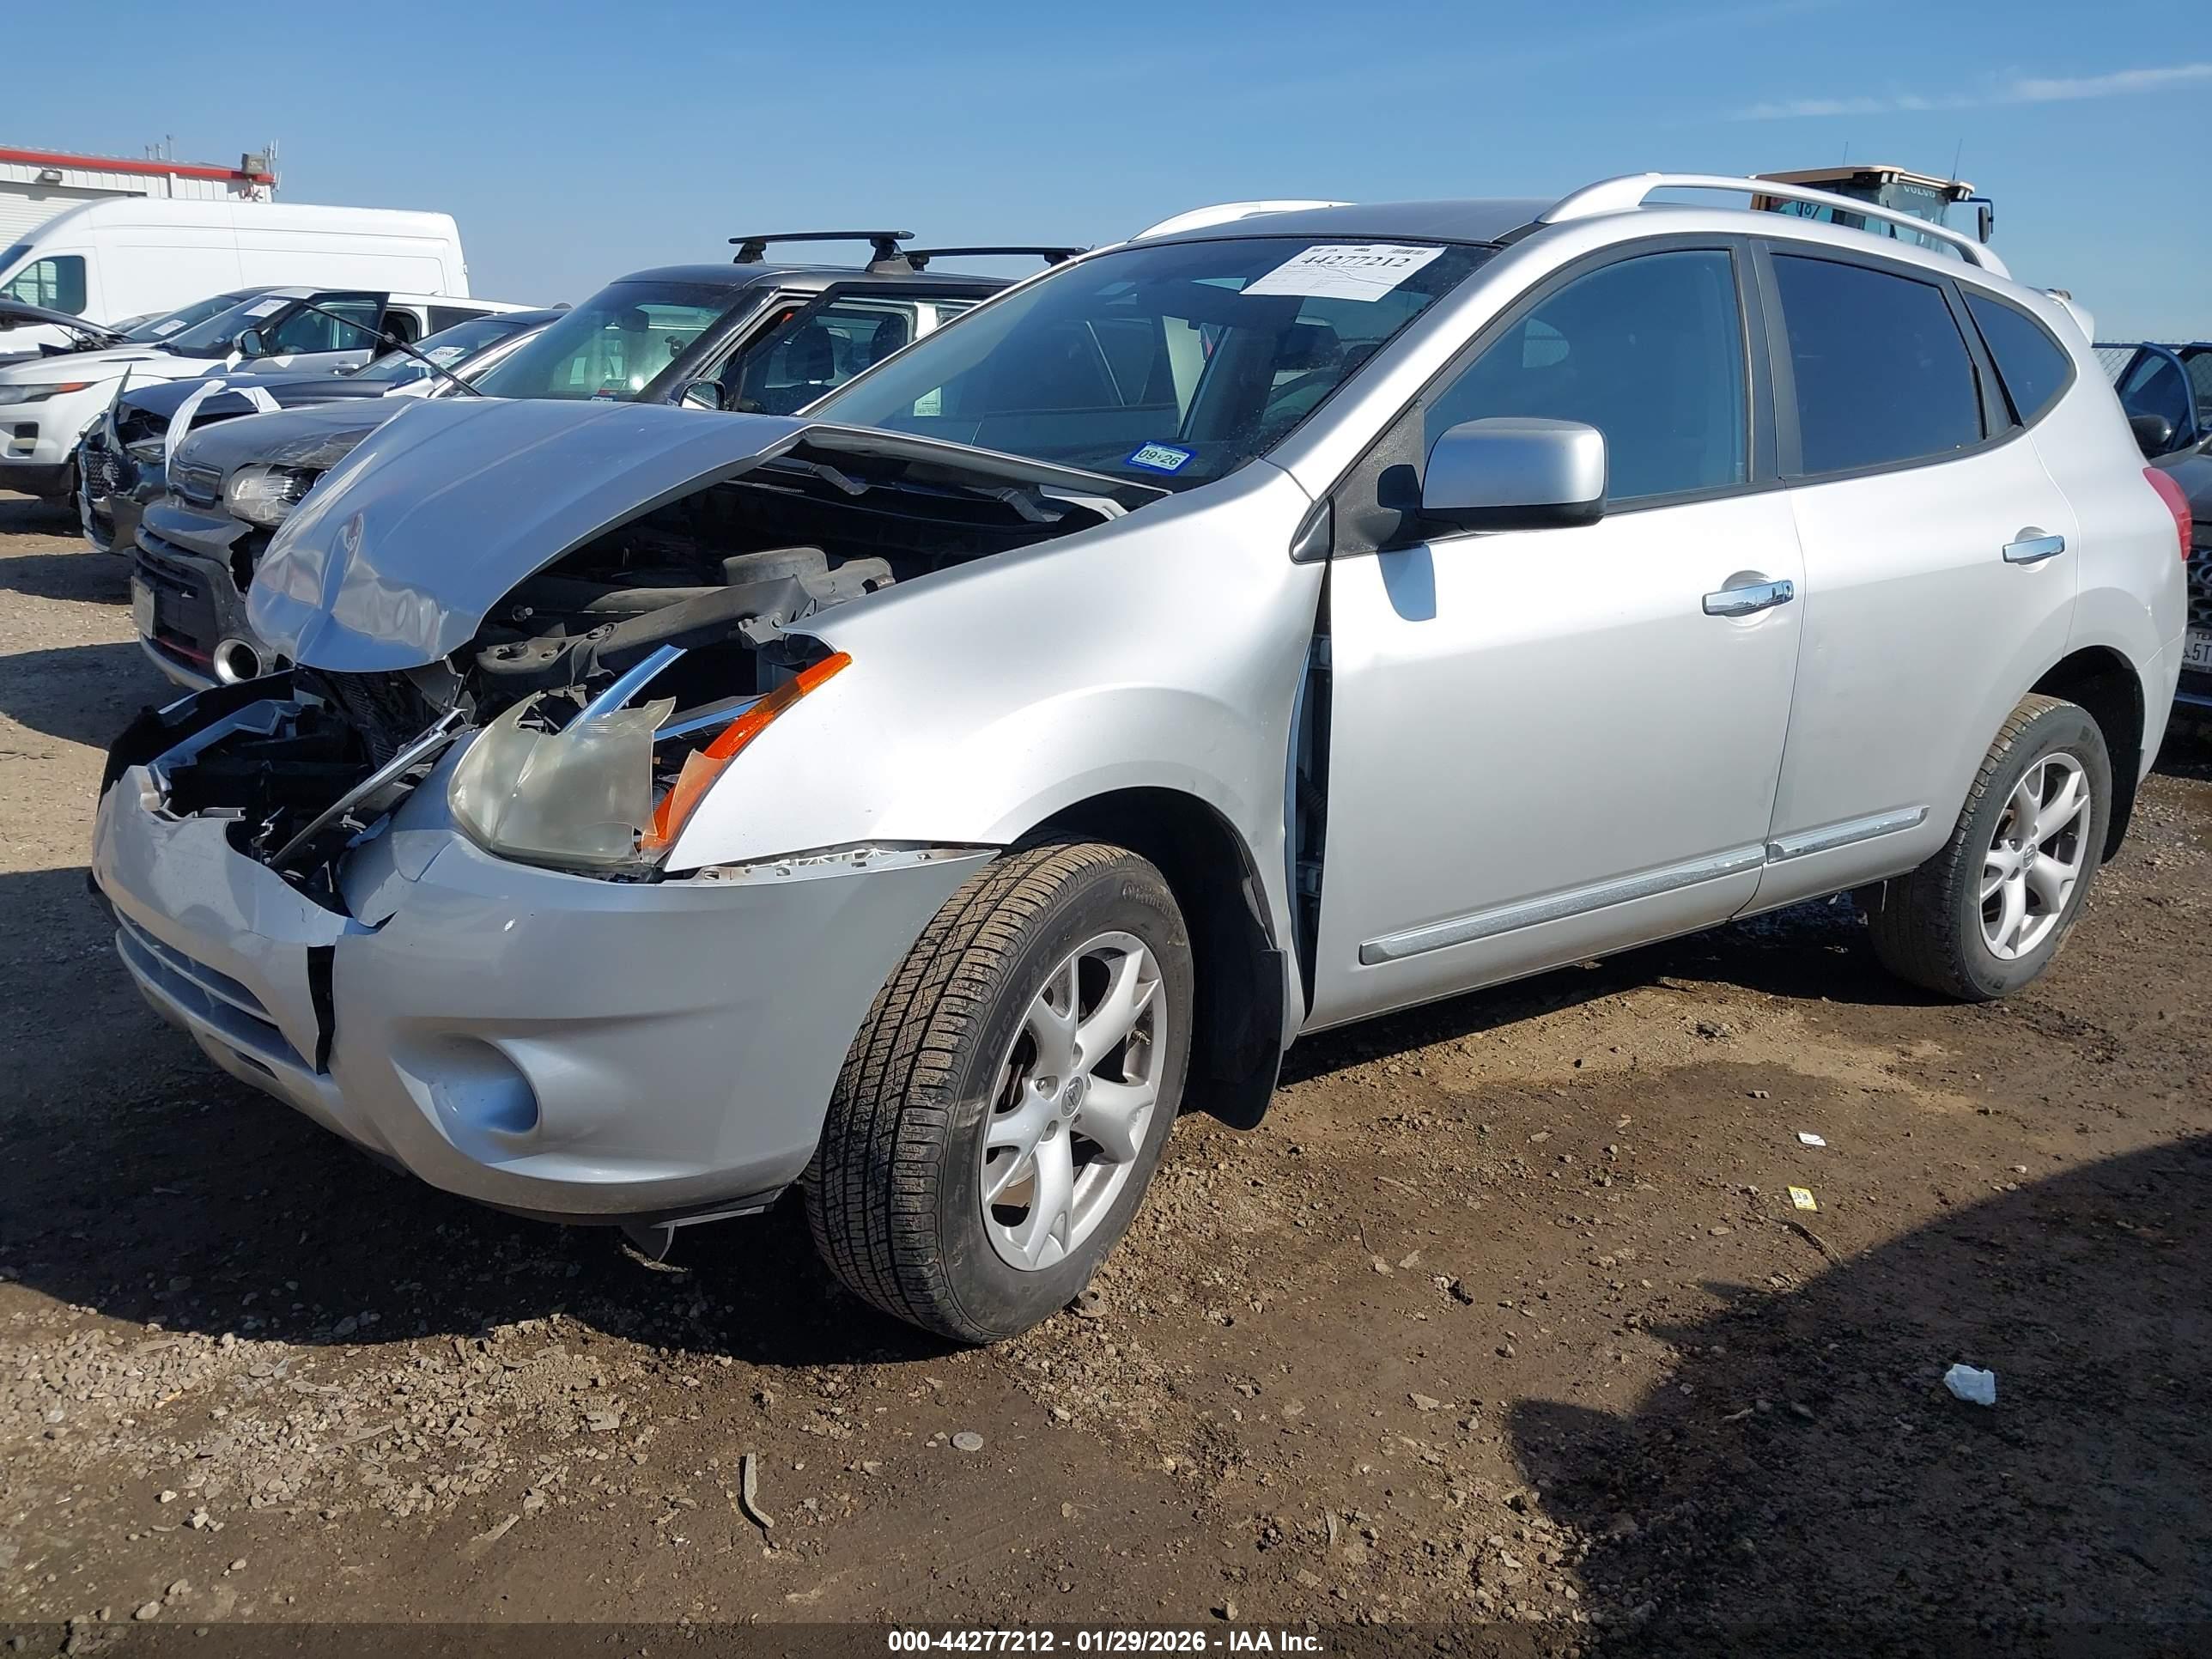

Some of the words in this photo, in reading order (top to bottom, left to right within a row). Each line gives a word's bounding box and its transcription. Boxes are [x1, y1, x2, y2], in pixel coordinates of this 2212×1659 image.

[1904, 185, 1936, 198] VOLVO
[1300, 255, 1412, 267] 44277212
[1159, 454, 1181, 465] 26
